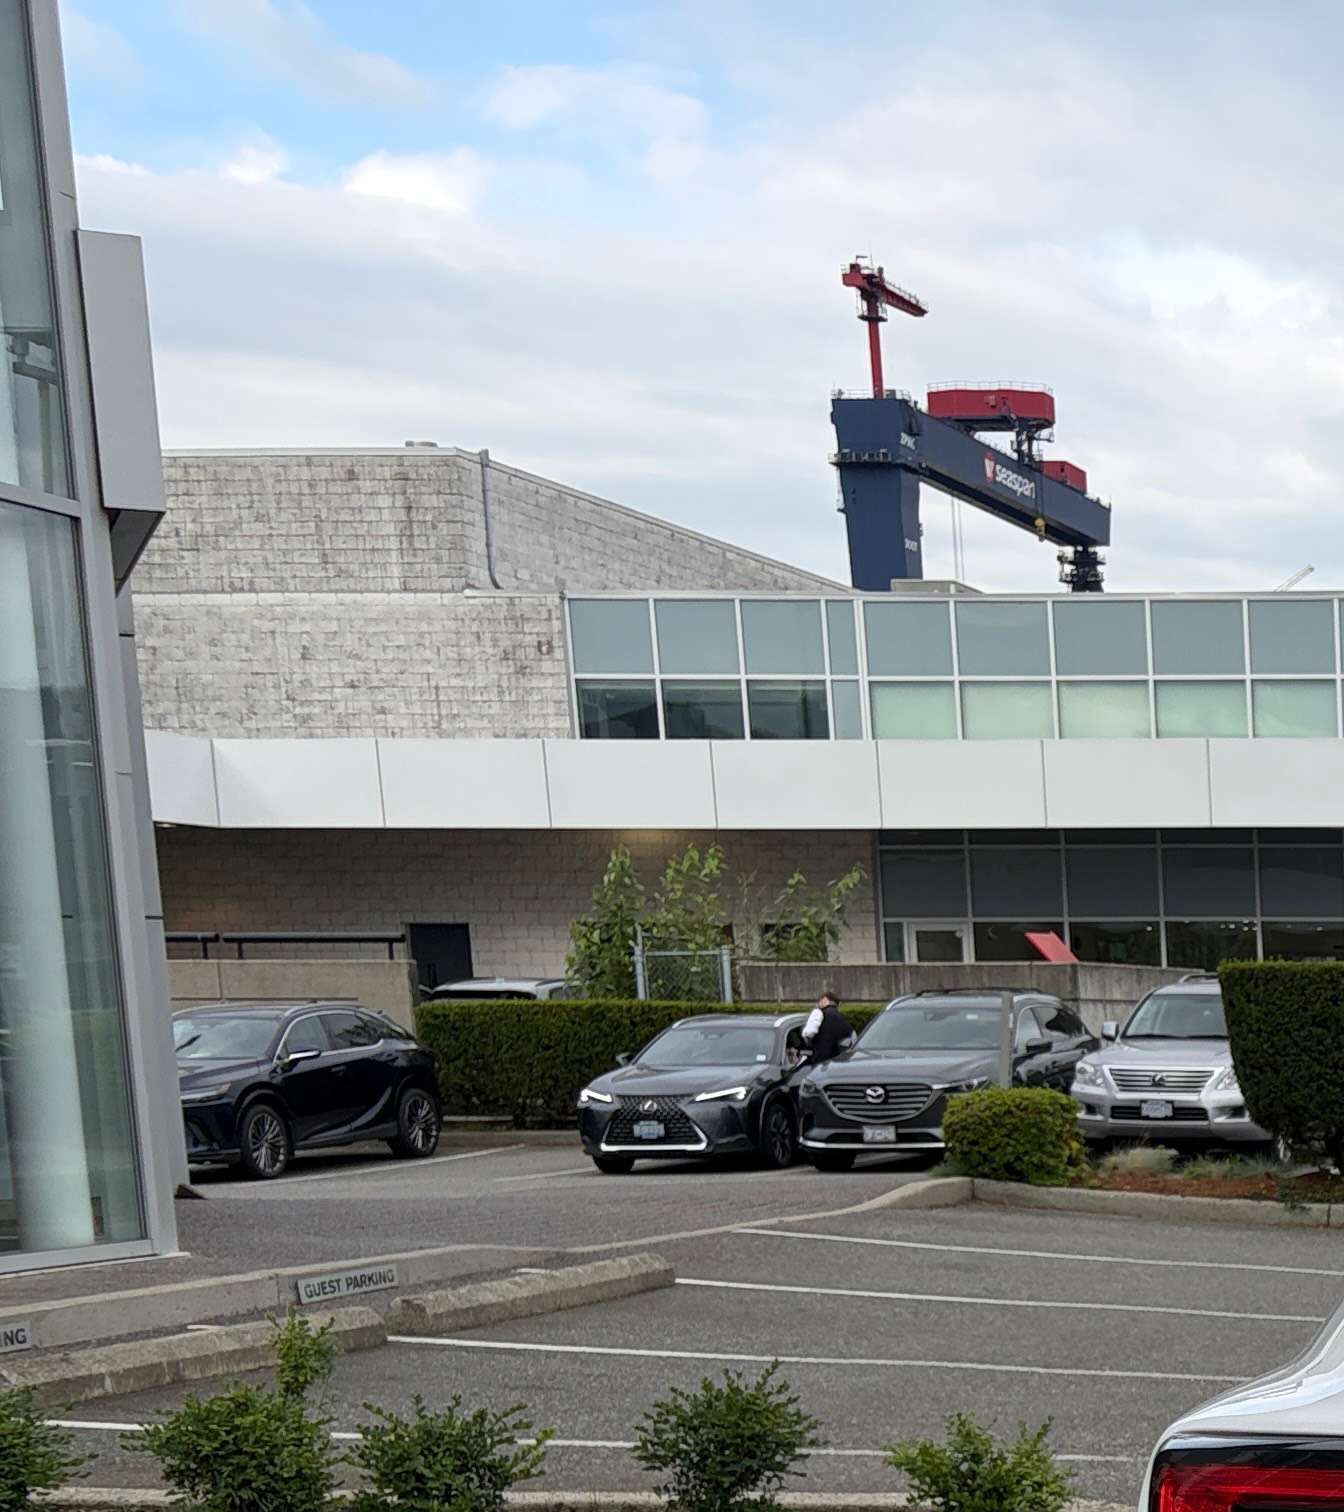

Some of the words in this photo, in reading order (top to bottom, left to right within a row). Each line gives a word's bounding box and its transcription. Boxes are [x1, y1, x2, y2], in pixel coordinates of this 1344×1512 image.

[995, 464, 1036, 498] seaspan
[304, 1278, 341, 1298] GUEST
[344, 1269, 395, 1291] PARKING
[0, 1328, 27, 1347] NG
